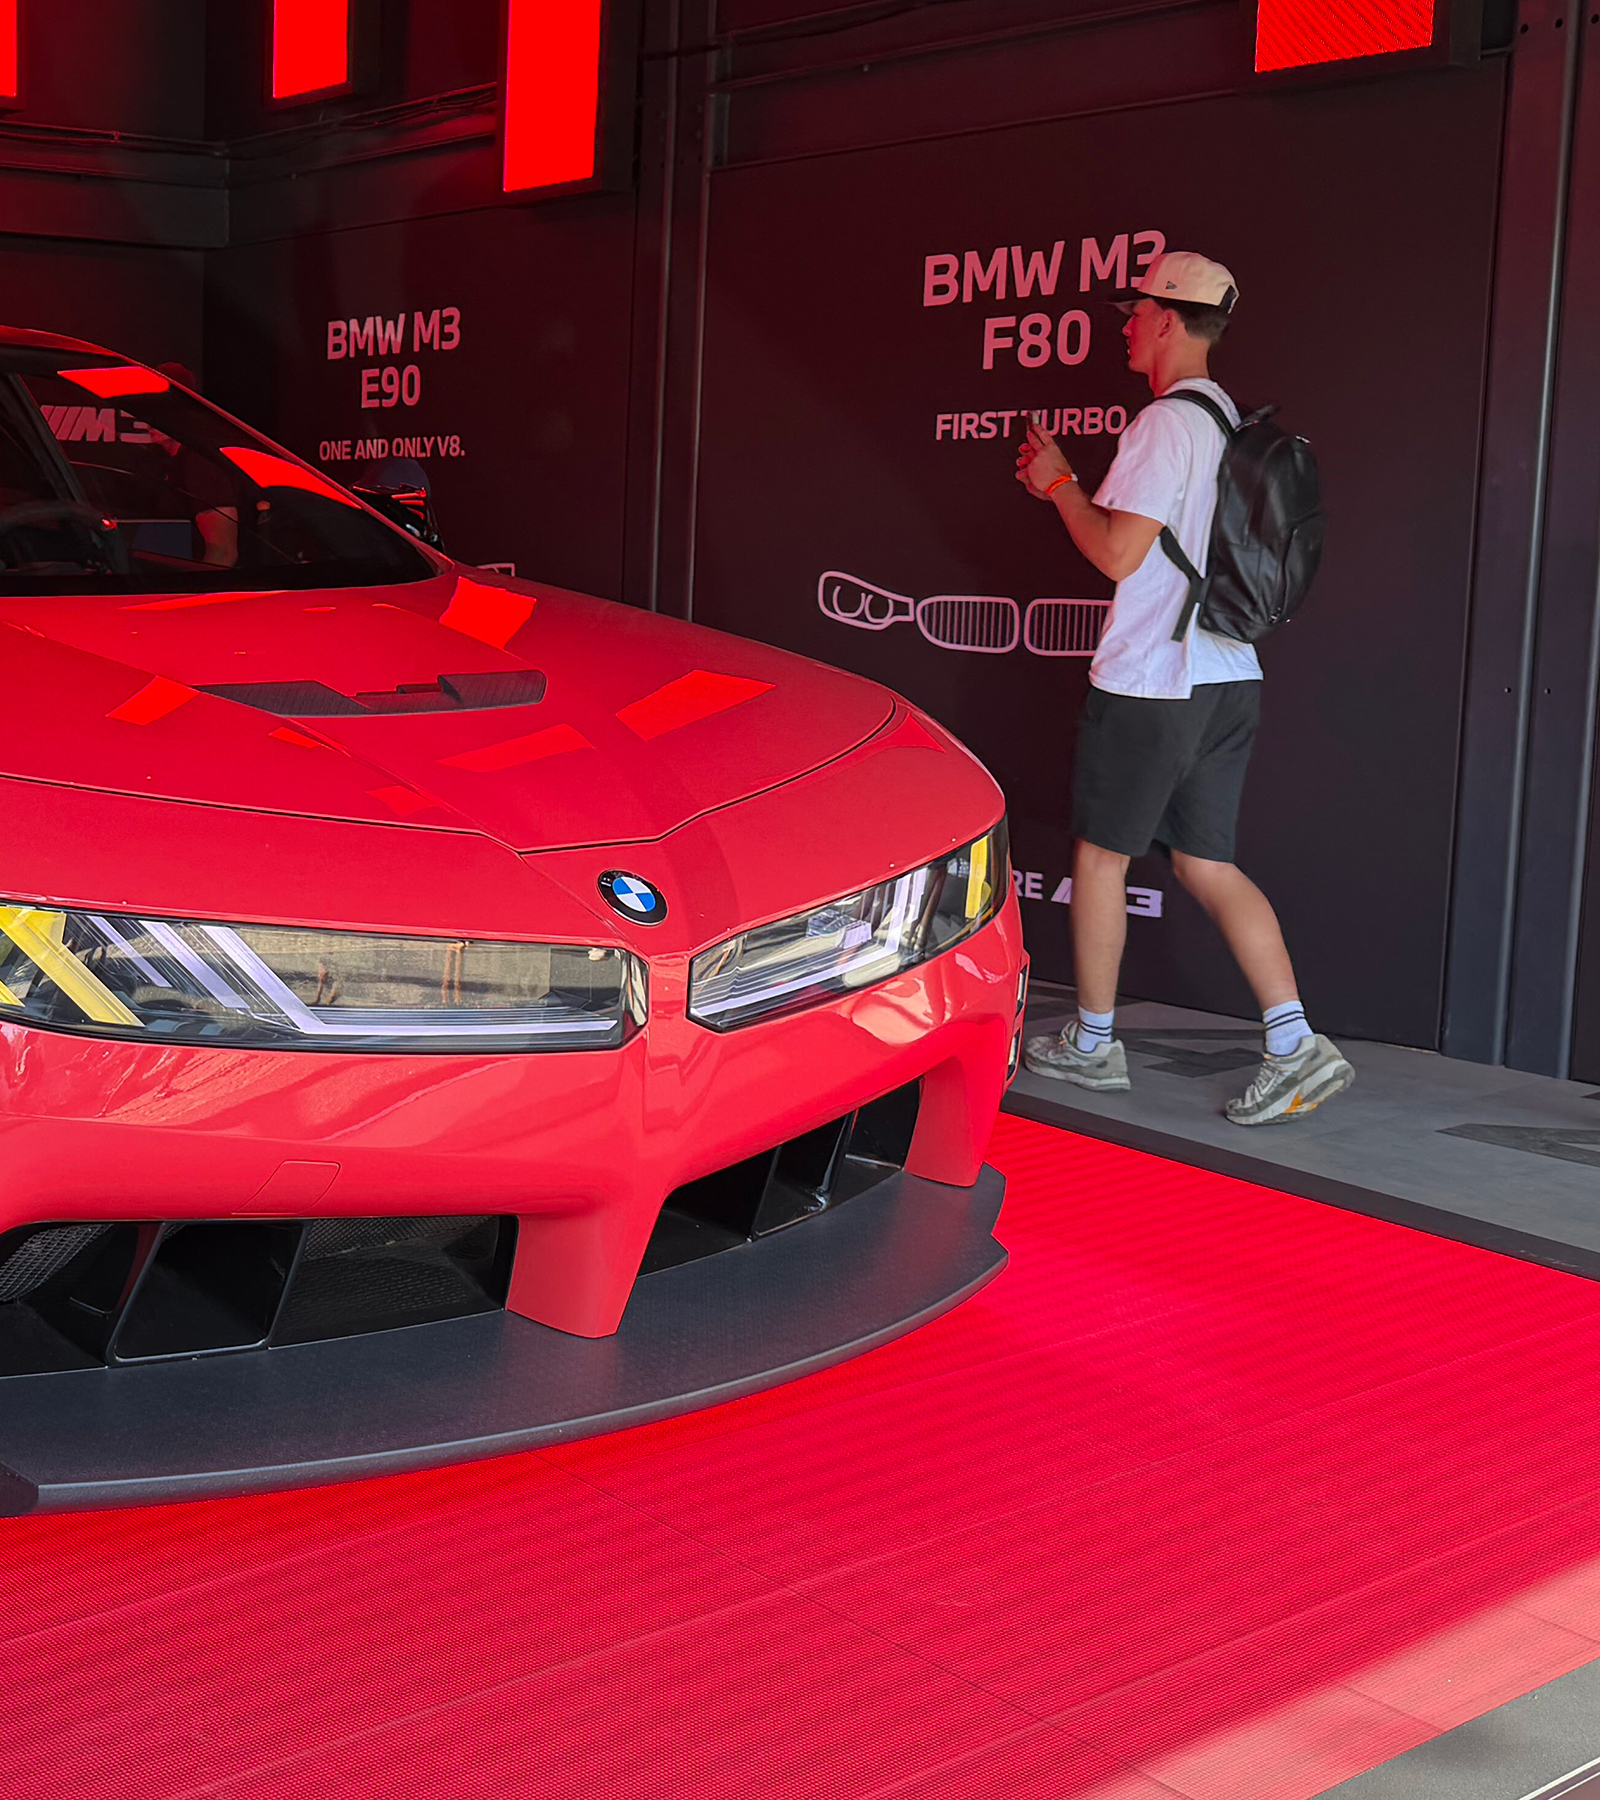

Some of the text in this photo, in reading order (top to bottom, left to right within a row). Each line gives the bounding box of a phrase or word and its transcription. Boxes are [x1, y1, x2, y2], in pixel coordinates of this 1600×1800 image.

[923, 230, 1166, 307] BMW M3
[326, 306, 461, 360] BMW M3
[982, 309, 1091, 370] F80
[360, 364, 421, 409] E90
[319, 435, 465, 461] ONE AND ONLY V8.
[935, 410, 1017, 441] FIRST
